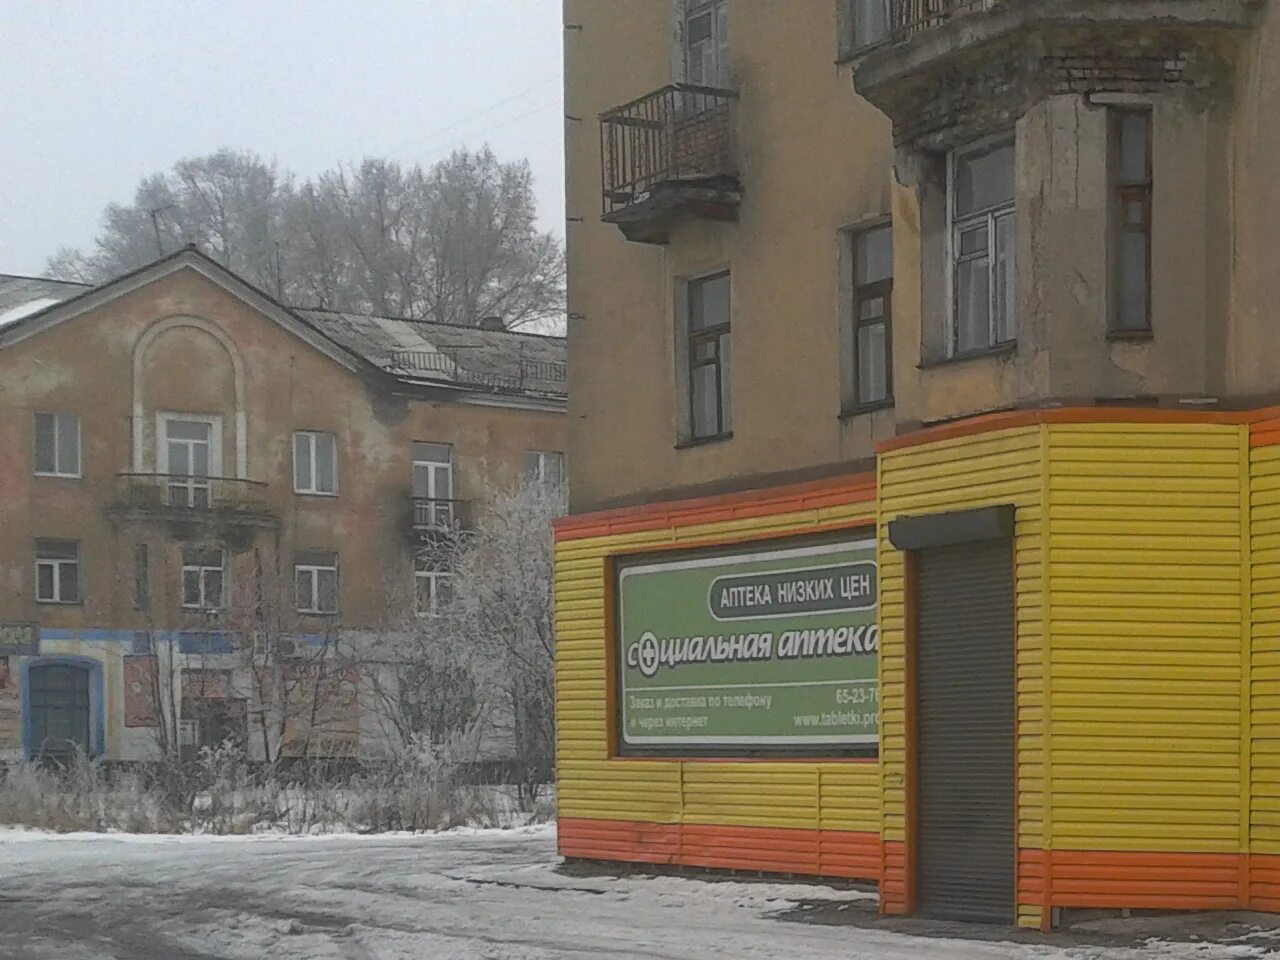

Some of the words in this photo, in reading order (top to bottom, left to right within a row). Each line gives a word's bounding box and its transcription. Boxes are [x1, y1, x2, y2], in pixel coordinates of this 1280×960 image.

[720, 584, 772, 608] АПТЕКА
[778, 577, 834, 603] НИЗКИХ
[840, 574, 870, 600] ЦЕН
[777, 624, 879, 658] аптека
